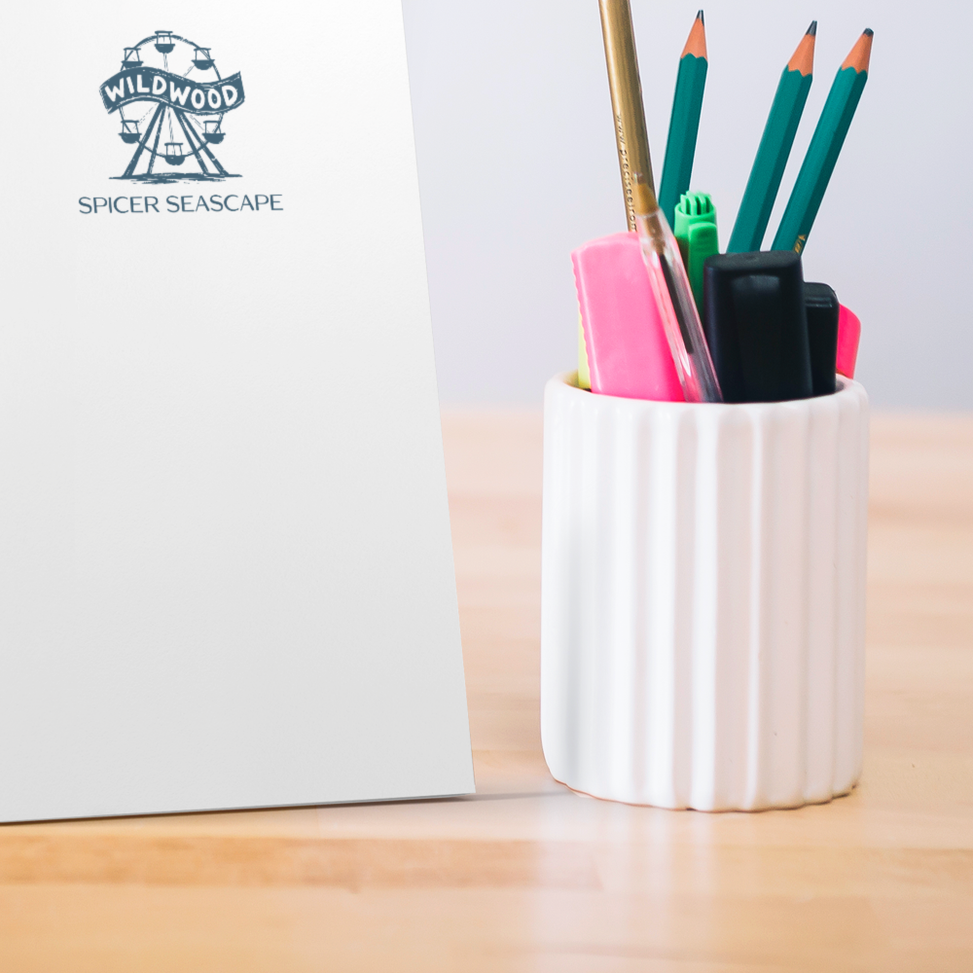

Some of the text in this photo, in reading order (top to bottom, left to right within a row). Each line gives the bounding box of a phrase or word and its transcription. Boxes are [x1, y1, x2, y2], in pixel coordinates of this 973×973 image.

[104, 74, 238, 109] WILDWOOD
[78, 194, 284, 214] SPICER SEASCAPE
